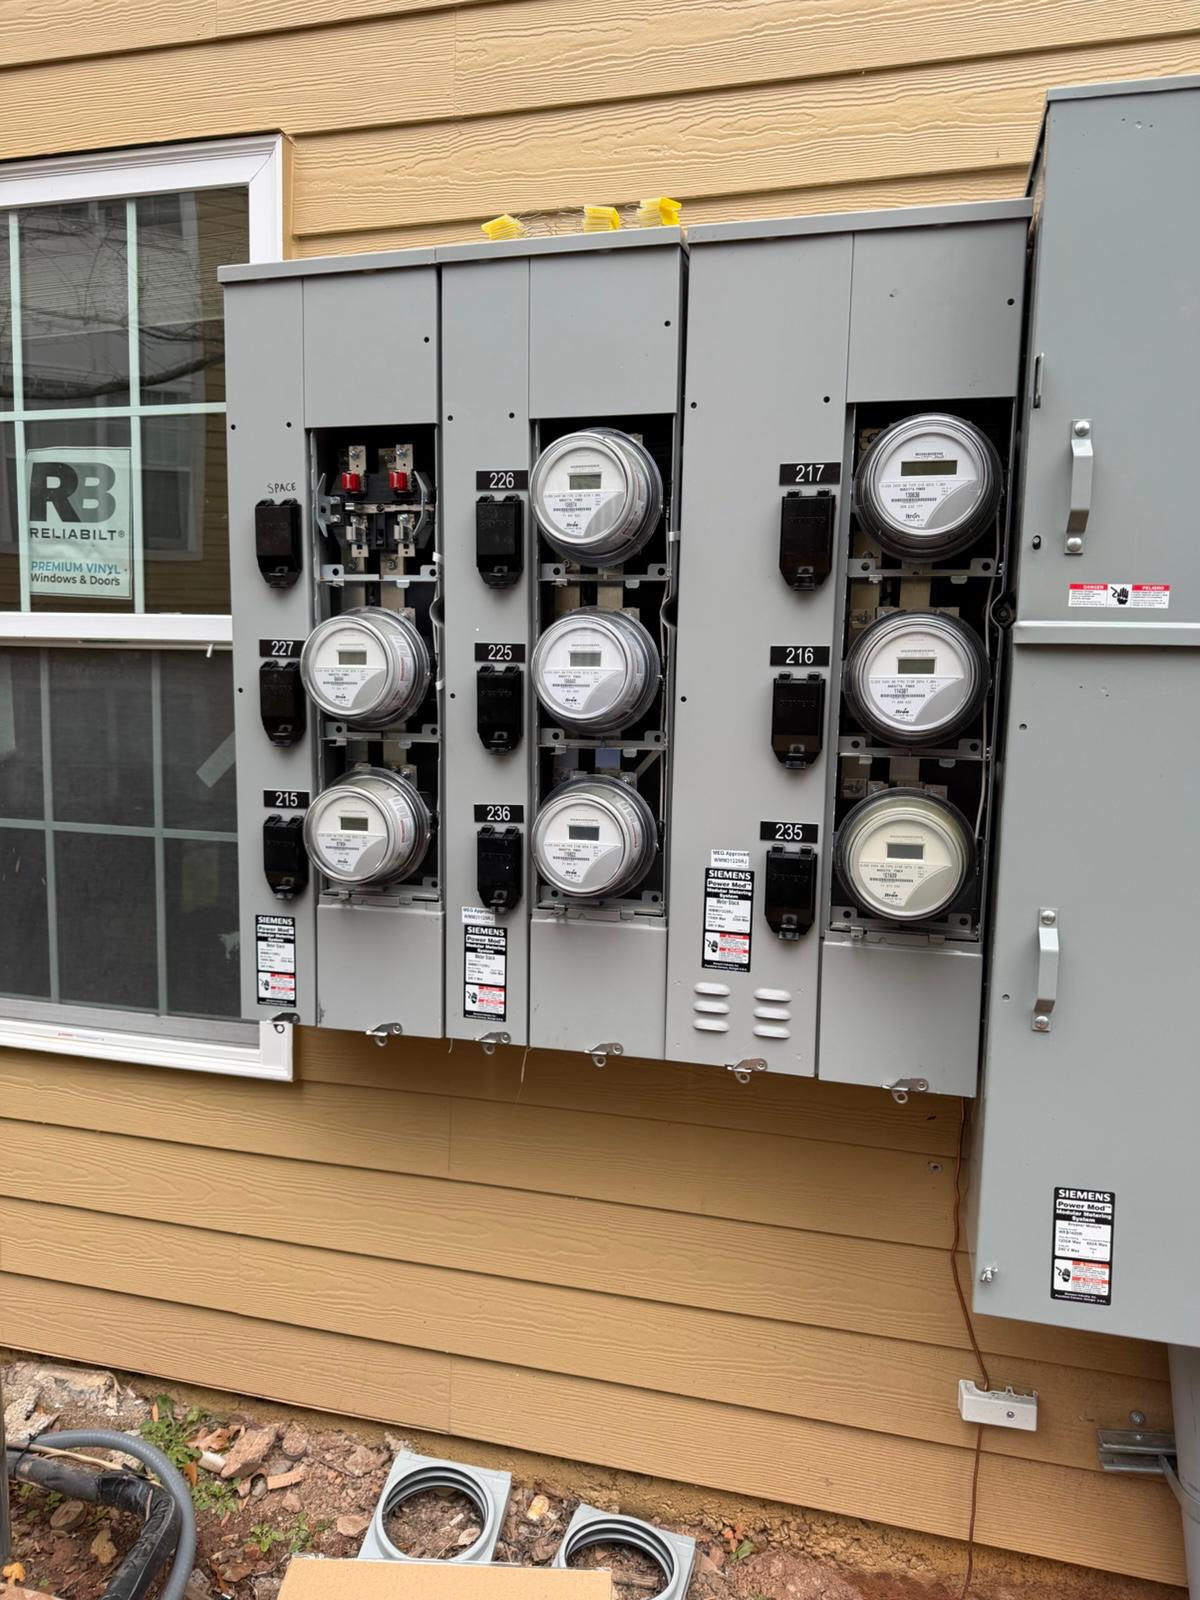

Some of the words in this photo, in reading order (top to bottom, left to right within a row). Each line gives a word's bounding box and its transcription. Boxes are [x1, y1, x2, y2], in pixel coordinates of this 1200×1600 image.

[489, 471, 515, 489] 226
[795, 464, 825, 483] 217
[267, 482, 297, 494] SPACE
[31, 561, 83, 572] PREMIUM
[86, 562, 121, 575] VINYL
[30, 573, 77, 584] Windows
[79, 575, 87, 584] &
[90, 576, 120, 586] Doors
[271, 640, 294, 656] 227
[488, 644, 512, 661] 225
[785, 647, 814, 665] 216
[275, 791, 298, 807] 215
[486, 805, 511, 822] 236
[775, 823, 803, 841] 235
[708, 870, 751, 880] SIEMENS
[258, 916, 294, 926] SIEMENS
[467, 926, 505, 936] SIEMENS
[1058, 1189, 1111, 1202] SIEMENS
[1058, 1201, 1085, 1209] Power
[1083, 1212, 1112, 1220] Metering
